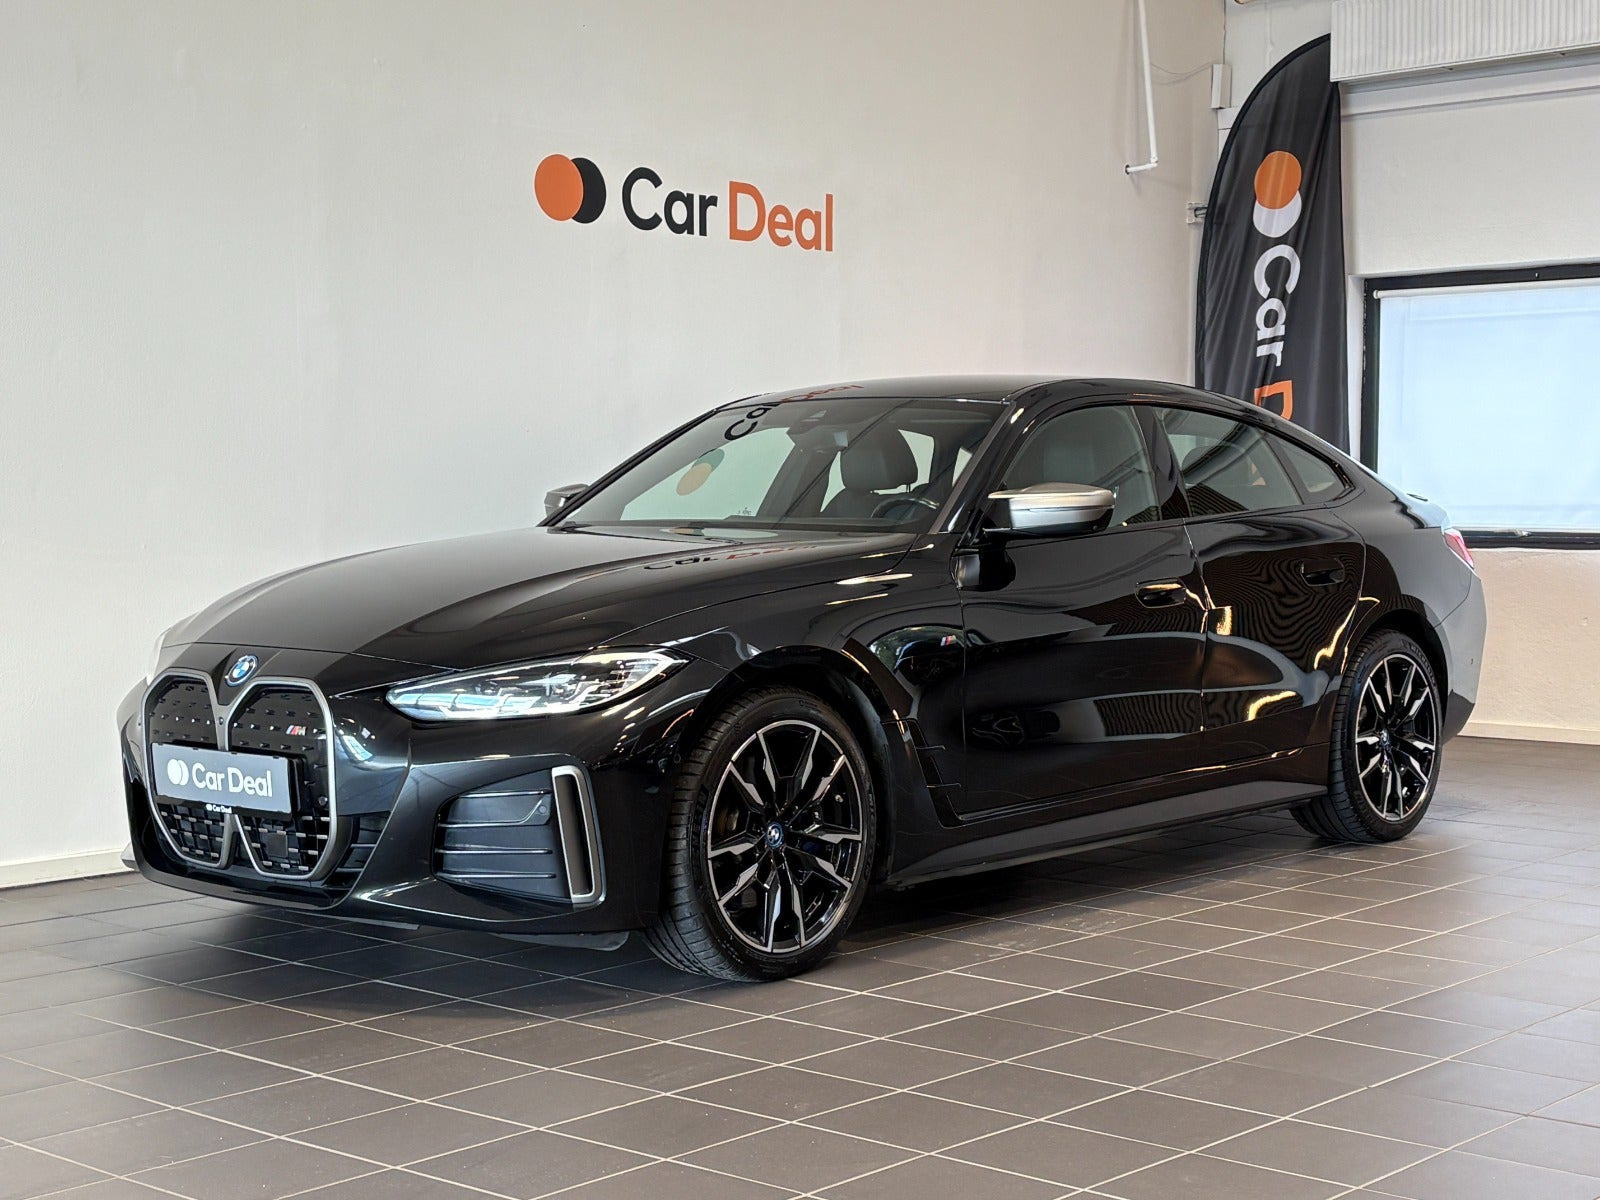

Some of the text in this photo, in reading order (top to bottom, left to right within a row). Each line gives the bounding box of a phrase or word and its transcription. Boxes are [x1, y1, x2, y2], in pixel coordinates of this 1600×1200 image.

[622, 166, 833, 252] Car Deal
[1253, 244, 1301, 367] Car
[192, 762, 273, 798] Car Deal
[212, 804, 221, 812] Car
